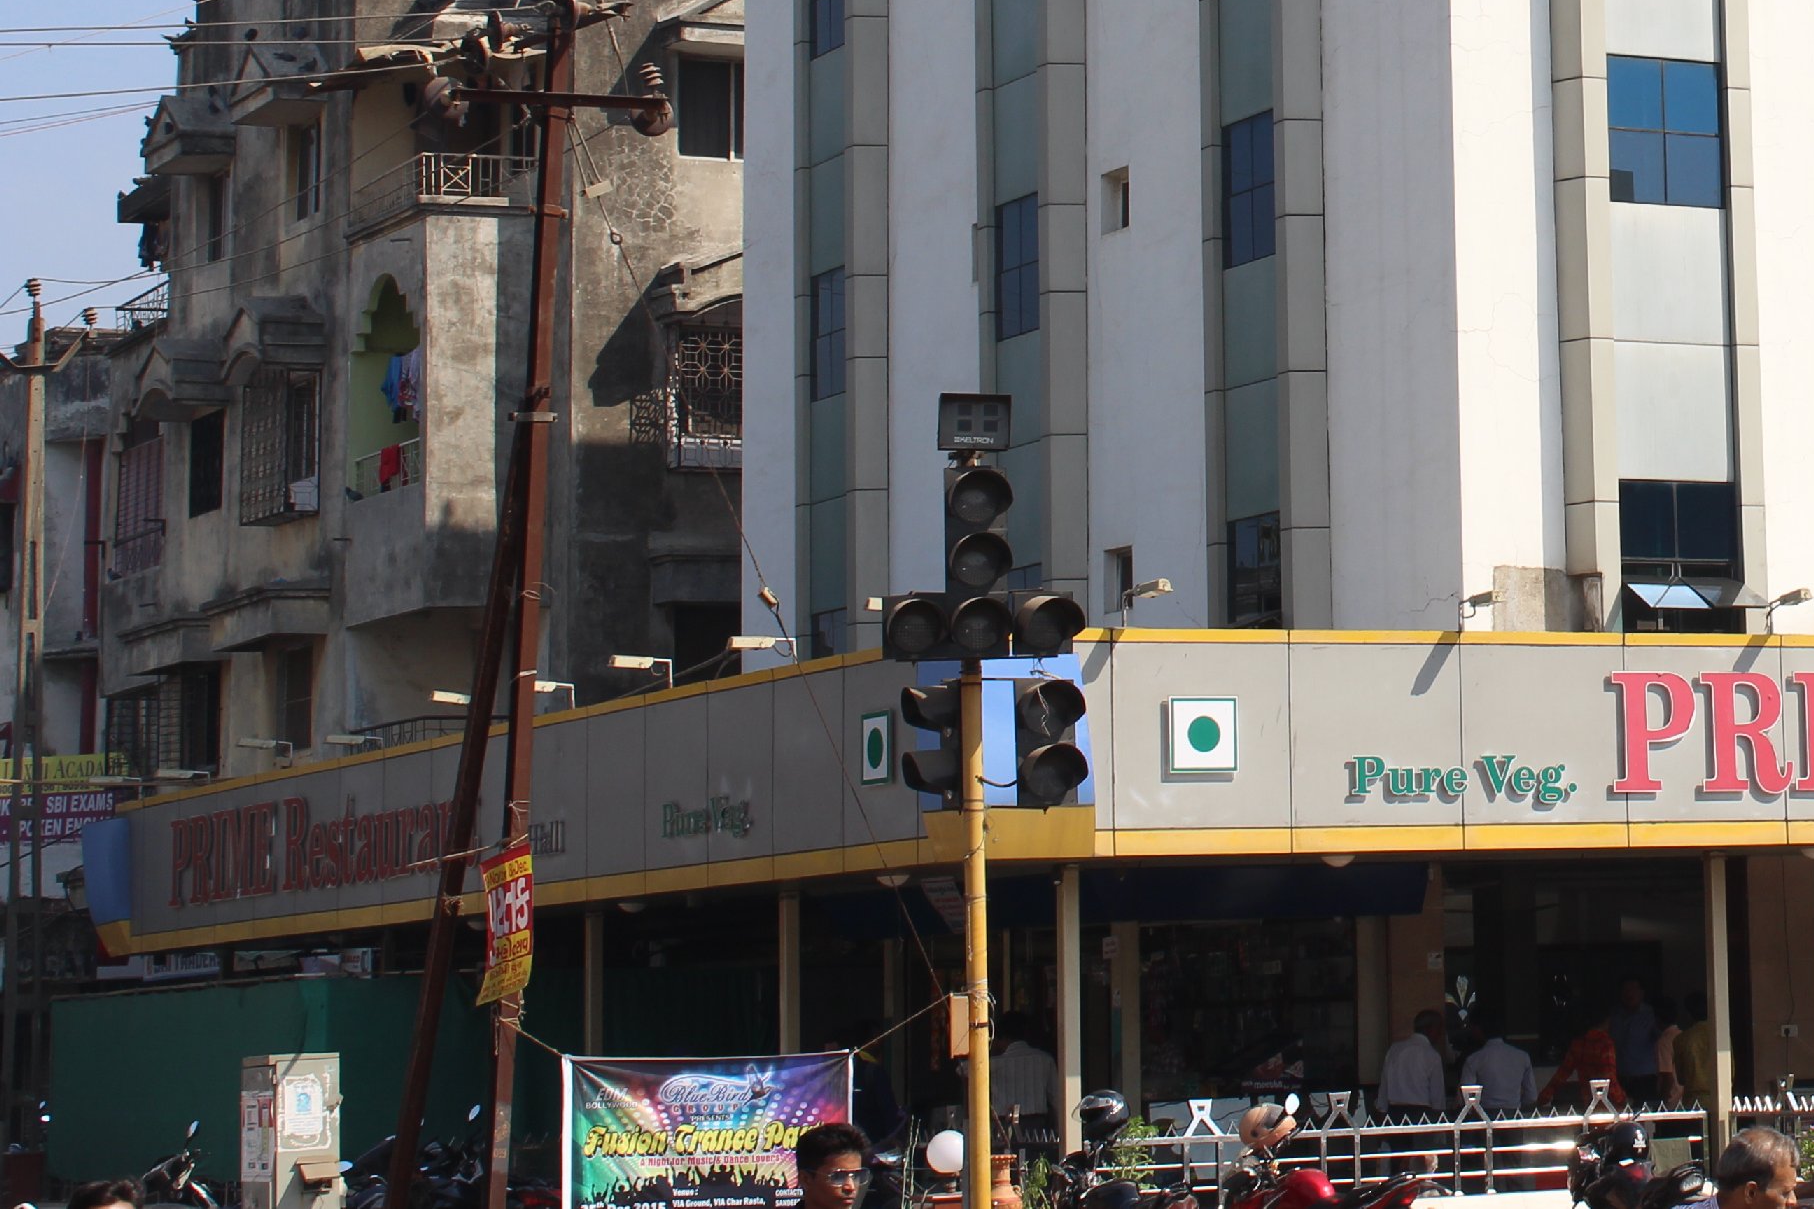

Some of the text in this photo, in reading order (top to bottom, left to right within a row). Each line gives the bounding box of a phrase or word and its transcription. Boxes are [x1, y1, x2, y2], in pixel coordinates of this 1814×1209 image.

[1351, 754, 1577, 801] Pure Veg.
[46, 796, 67, 813] SBI
[71, 792, 113, 812] EXAMS
[167, 793, 481, 908] PRIME Restaura
[673, 1103, 739, 1113] GROUP
[583, 1125, 668, 1158] Fusion
[674, 1123, 759, 1155] Trance
